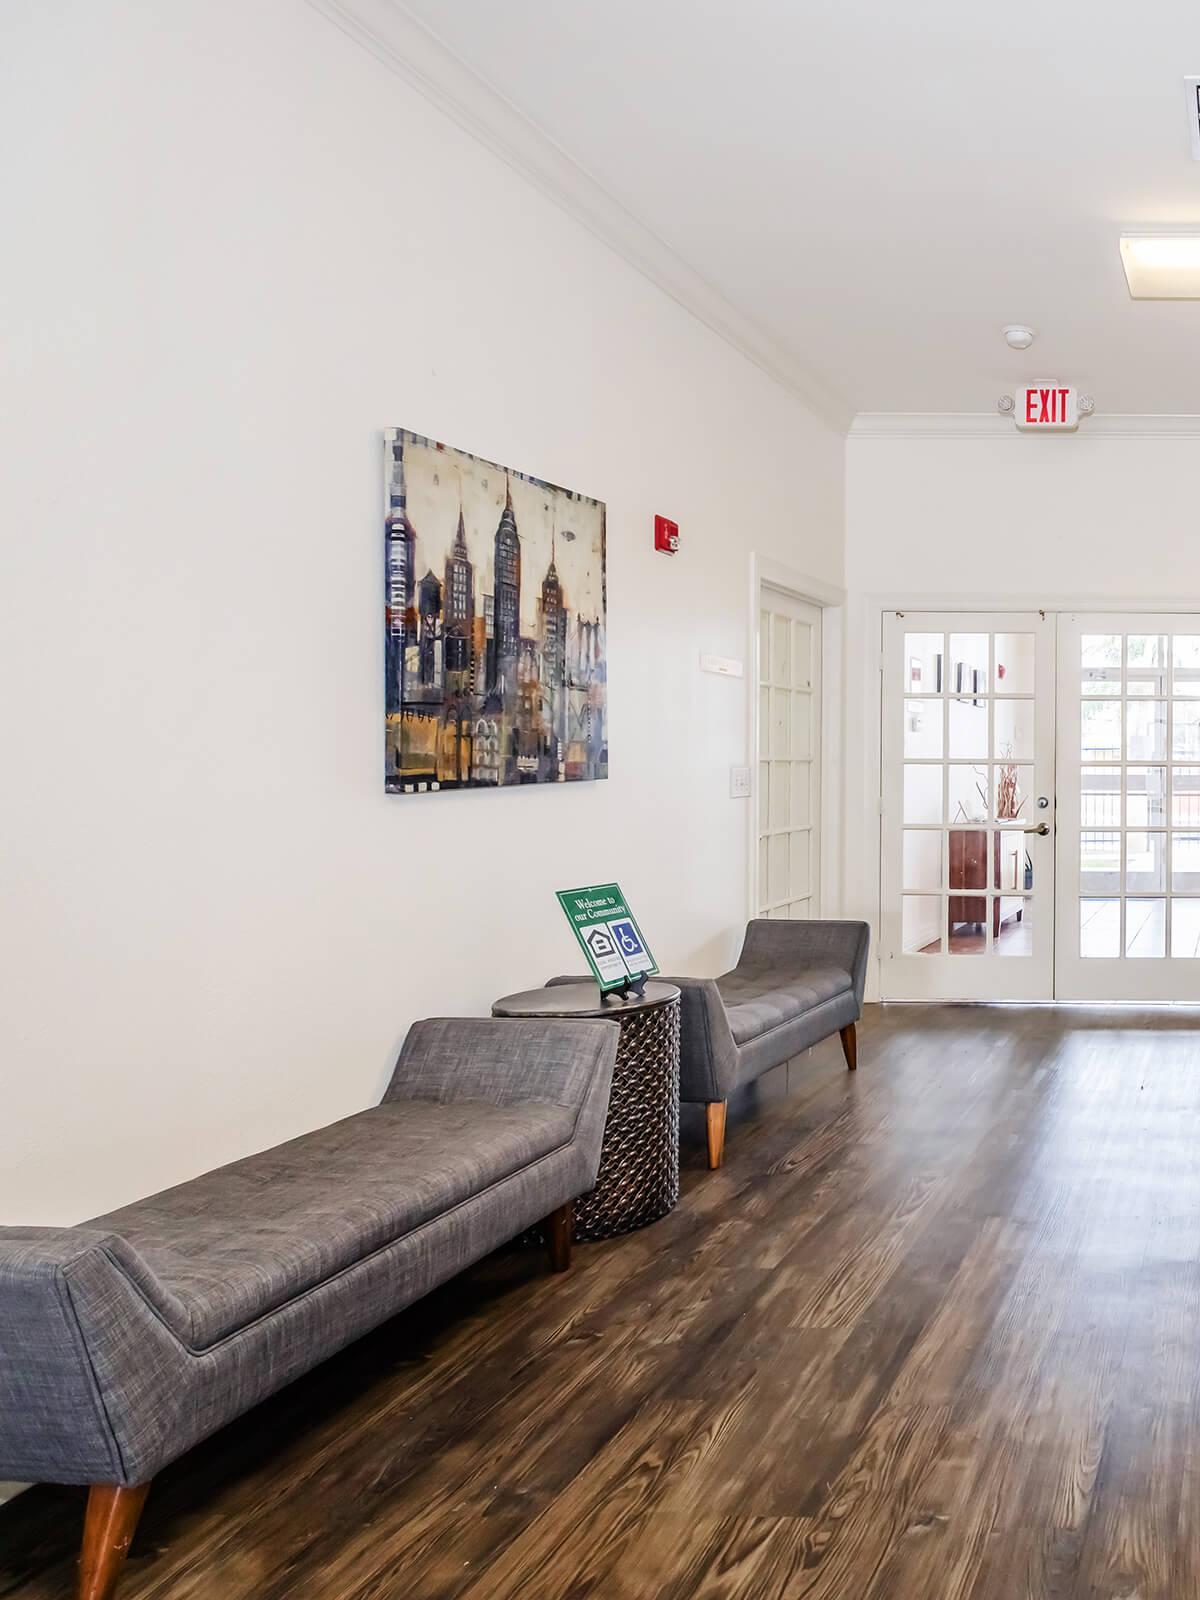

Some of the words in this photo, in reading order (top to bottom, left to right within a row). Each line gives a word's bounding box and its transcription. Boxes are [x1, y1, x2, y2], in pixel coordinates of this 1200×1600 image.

[1026, 389, 1069, 422] EXIT
[575, 898, 607, 909] Welcome
[587, 905, 626, 918] Community
